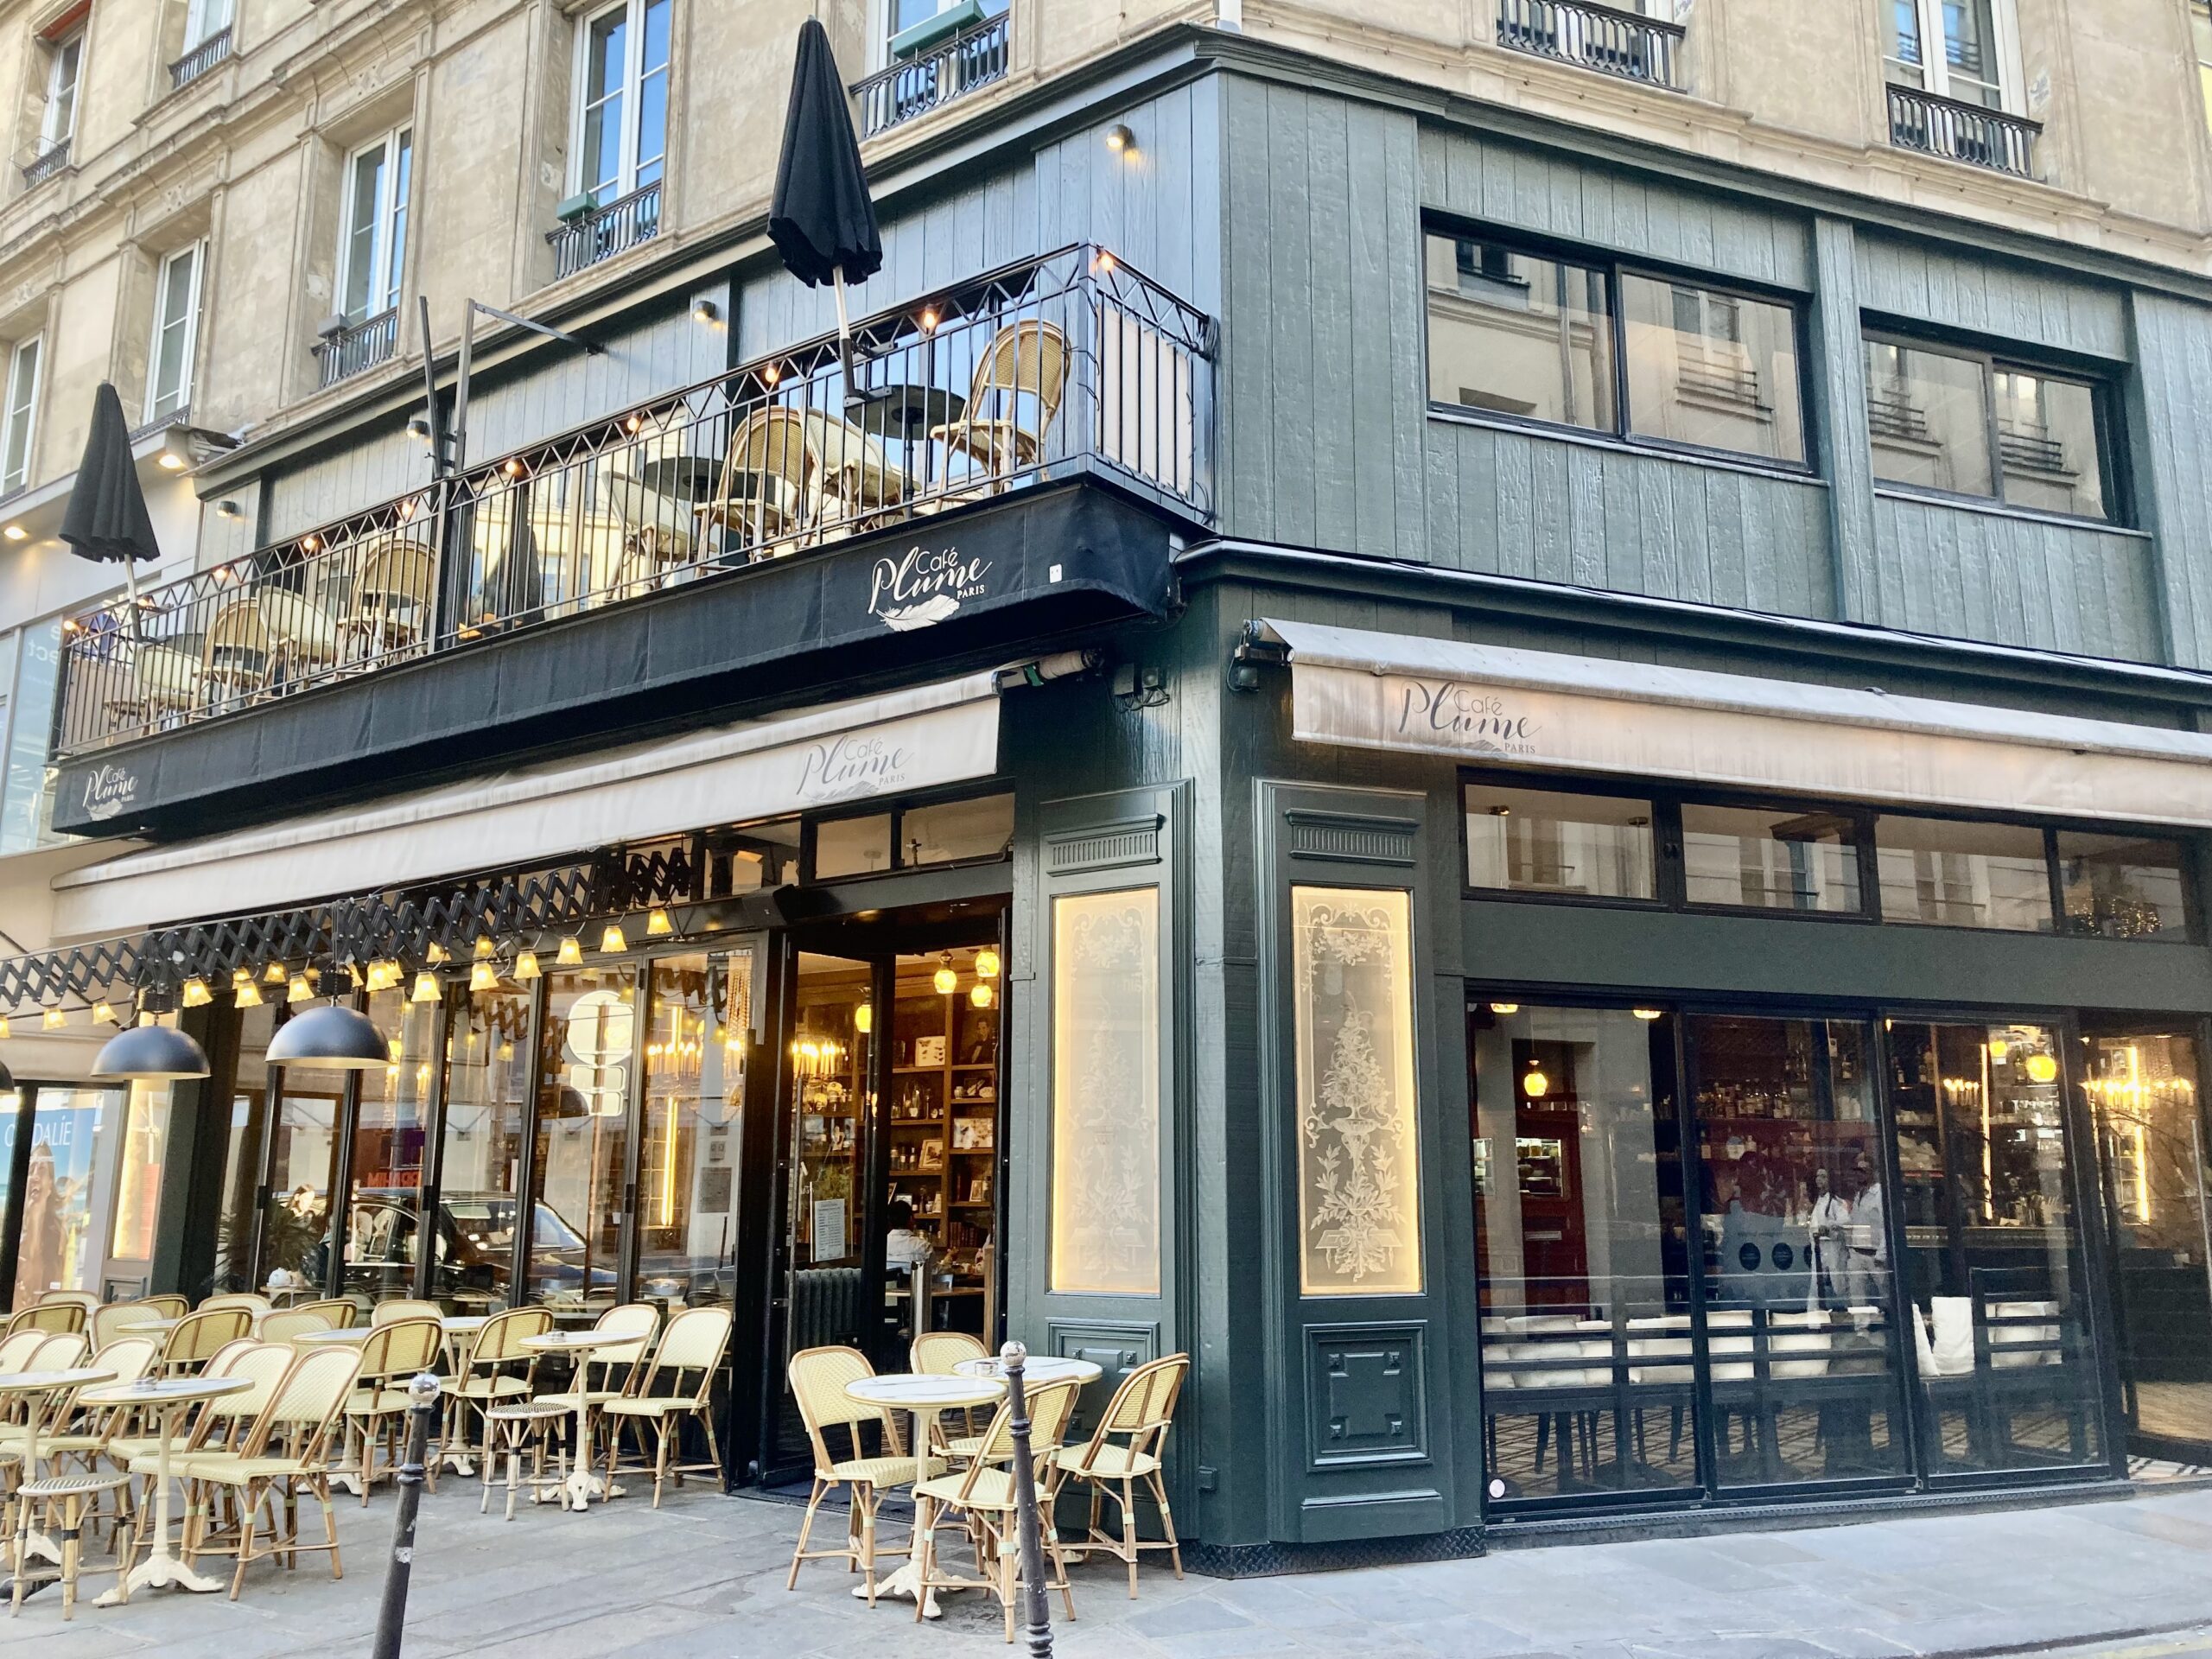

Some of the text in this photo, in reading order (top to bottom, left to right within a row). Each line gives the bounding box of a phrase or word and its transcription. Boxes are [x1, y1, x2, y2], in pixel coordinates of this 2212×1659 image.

[915, 546, 958, 575] Café
[868, 545, 993, 614] Plume
[957, 584, 986, 600] PARIS
[1398, 680, 1542, 741] Plume
[1453, 689, 1503, 716] Café
[843, 736, 884, 761] Café
[1504, 741, 1535, 754] PARIS
[105, 766, 126, 784] Café
[796, 734, 915, 795] Plume
[82, 764, 138, 808] Plume
[878, 772, 906, 787] PARIS
